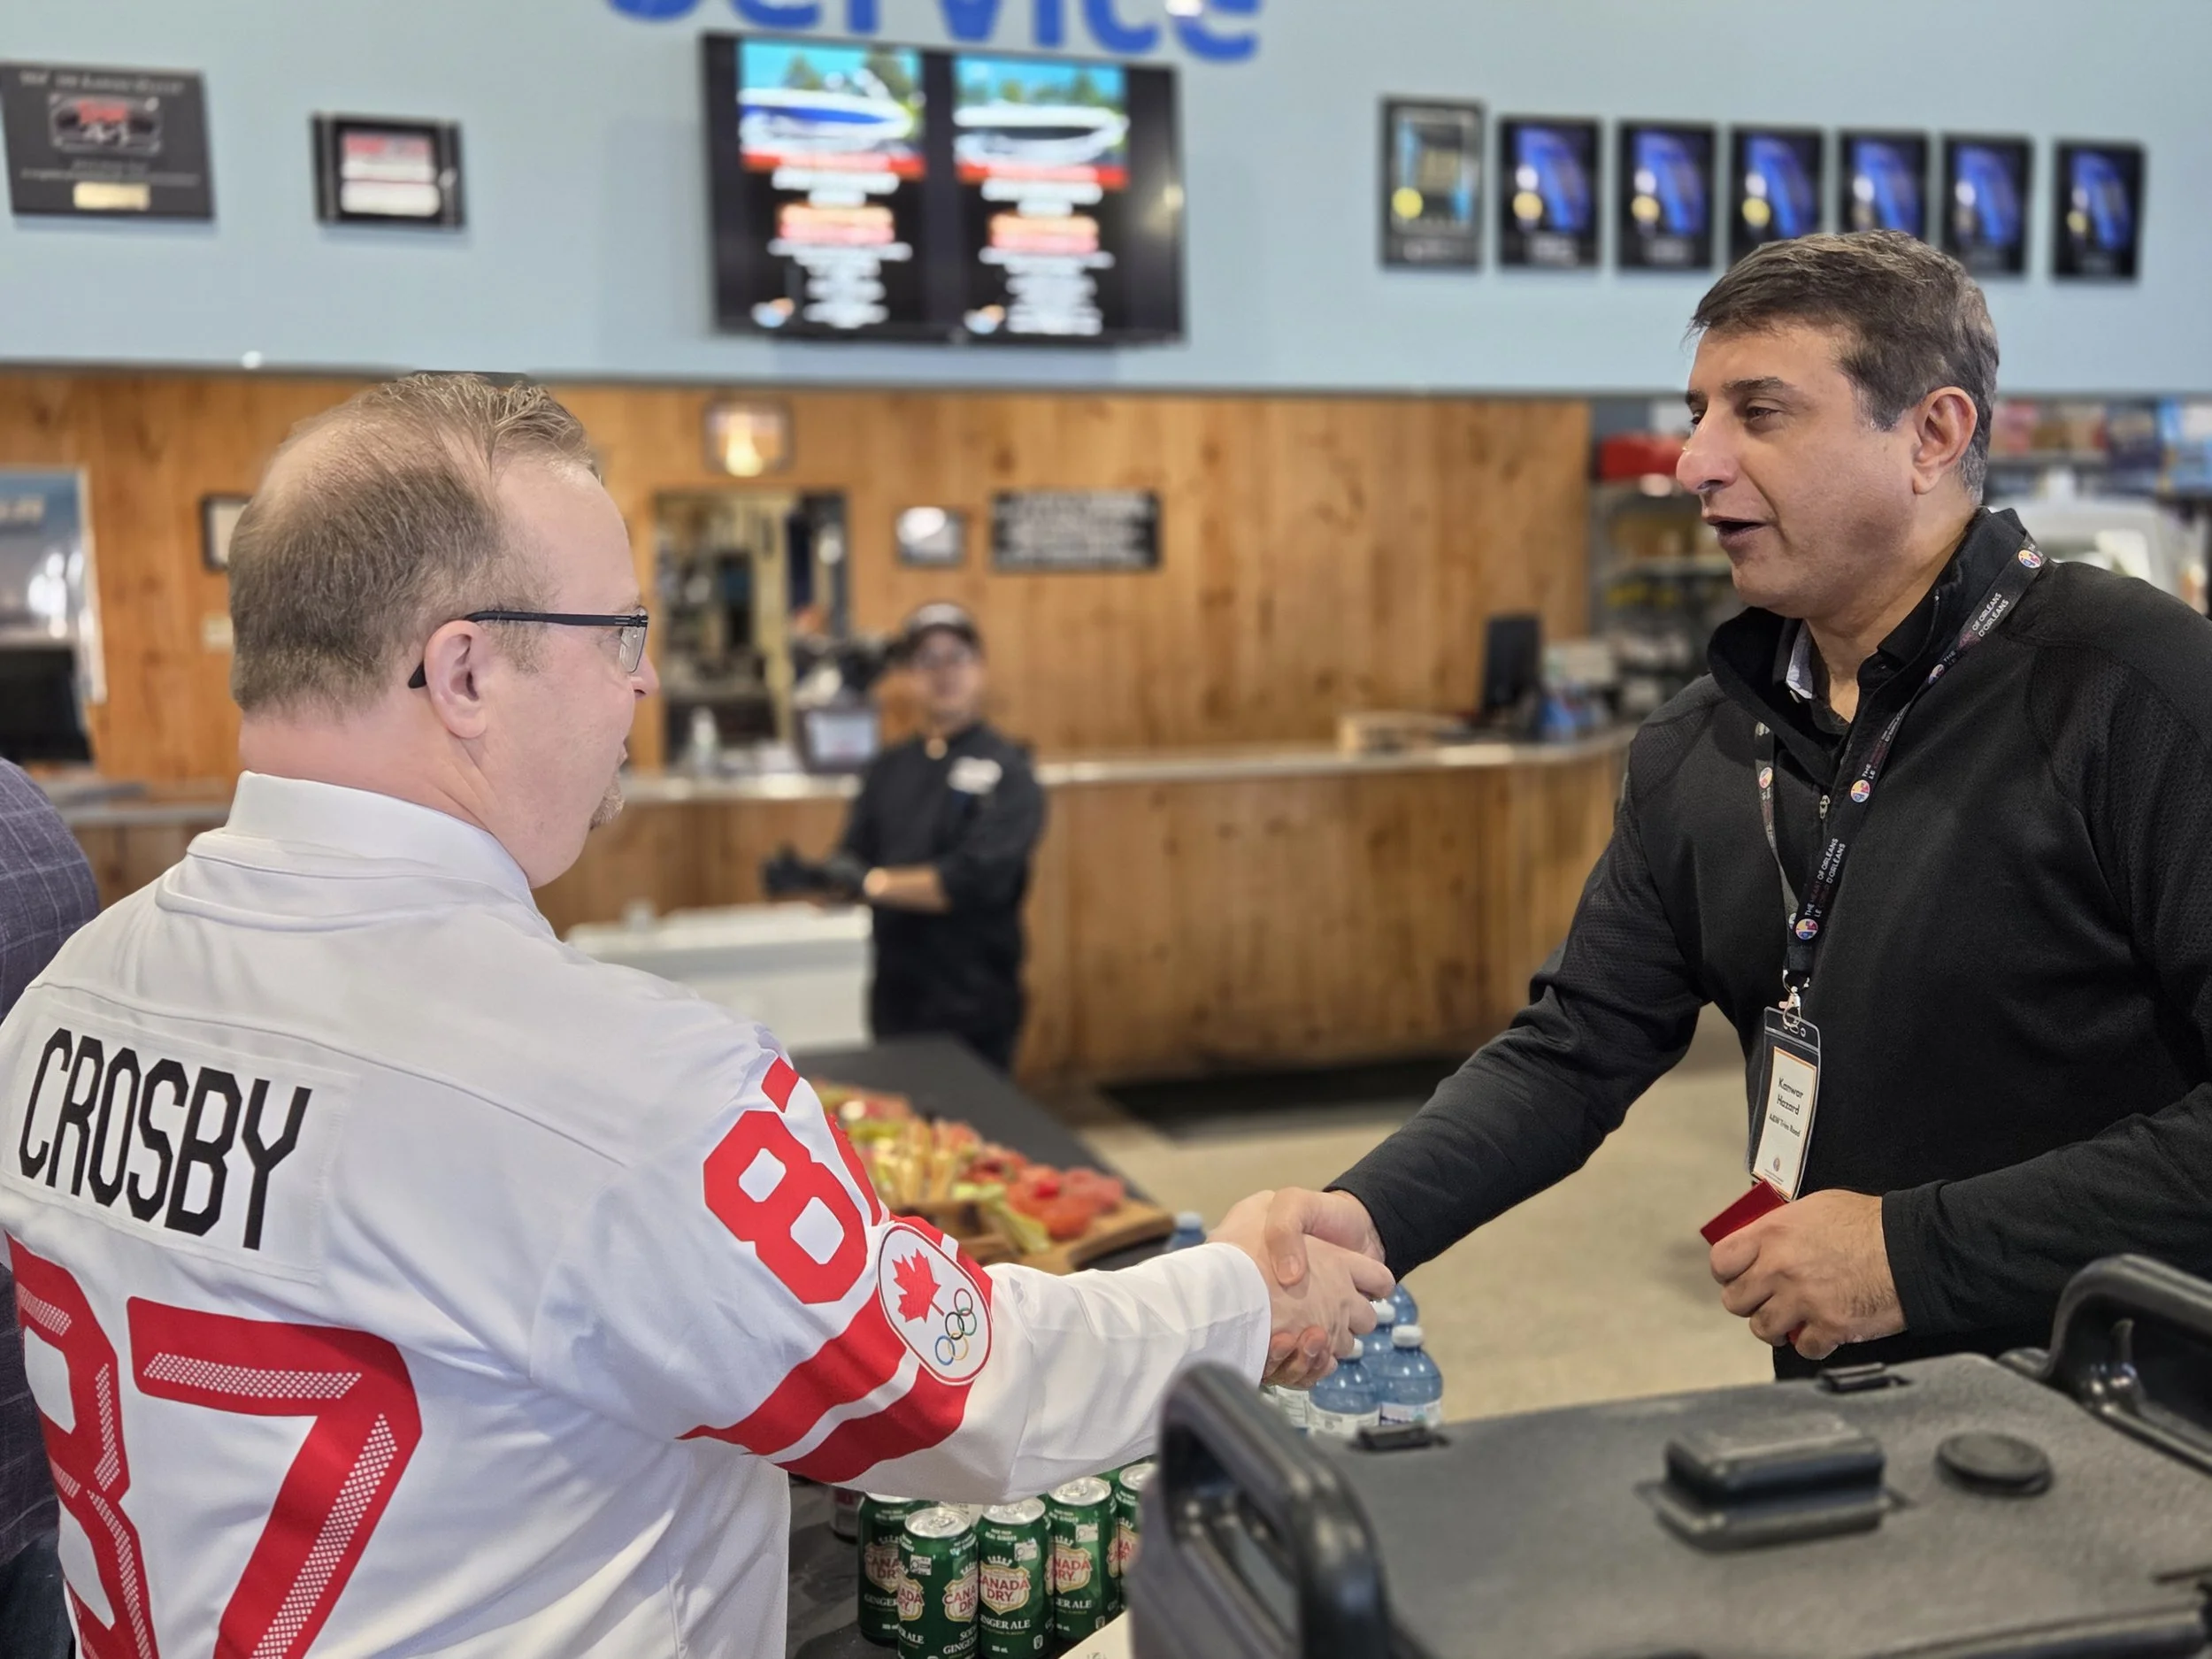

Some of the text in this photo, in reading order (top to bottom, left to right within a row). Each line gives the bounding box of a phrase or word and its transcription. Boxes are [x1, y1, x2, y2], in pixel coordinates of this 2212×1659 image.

[1804, 902, 1815, 916] THE
[1814, 909, 1822, 918] LE
[19, 1027, 313, 1251] CROSBY
[864, 1553, 900, 1568] CANA
[1053, 1558, 1091, 1571] NADA
[877, 1569, 896, 1579] DR
[979, 1574, 1031, 1591] ANADA
[899, 1587, 923, 1604] ADA
[943, 1585, 976, 1604] CANA
[959, 1595, 976, 1613] DR
[979, 1614, 1031, 1630] INGER ALE
[907, 1632, 925, 1644] ALE
